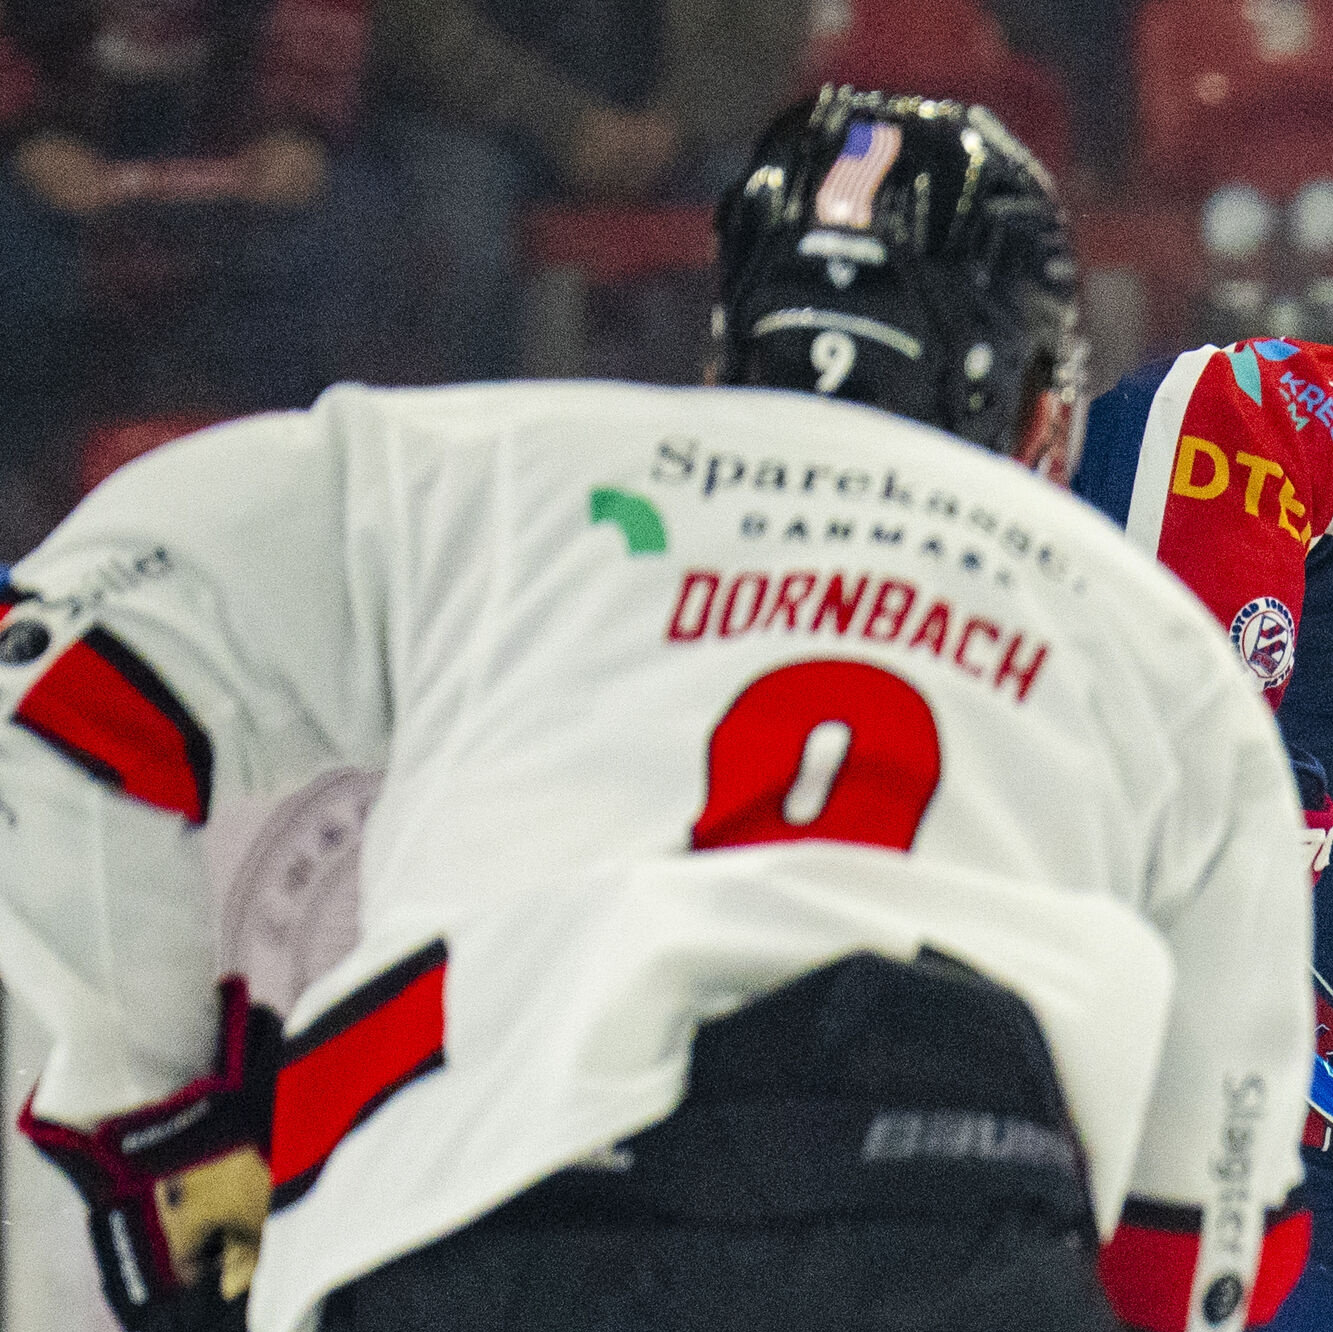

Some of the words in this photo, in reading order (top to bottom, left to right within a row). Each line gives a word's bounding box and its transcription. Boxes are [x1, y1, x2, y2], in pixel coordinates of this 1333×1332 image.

[811, 331, 855, 393] 9
[1172, 434, 1312, 546] DTE
[665, 570, 1052, 704] DORNBACH
